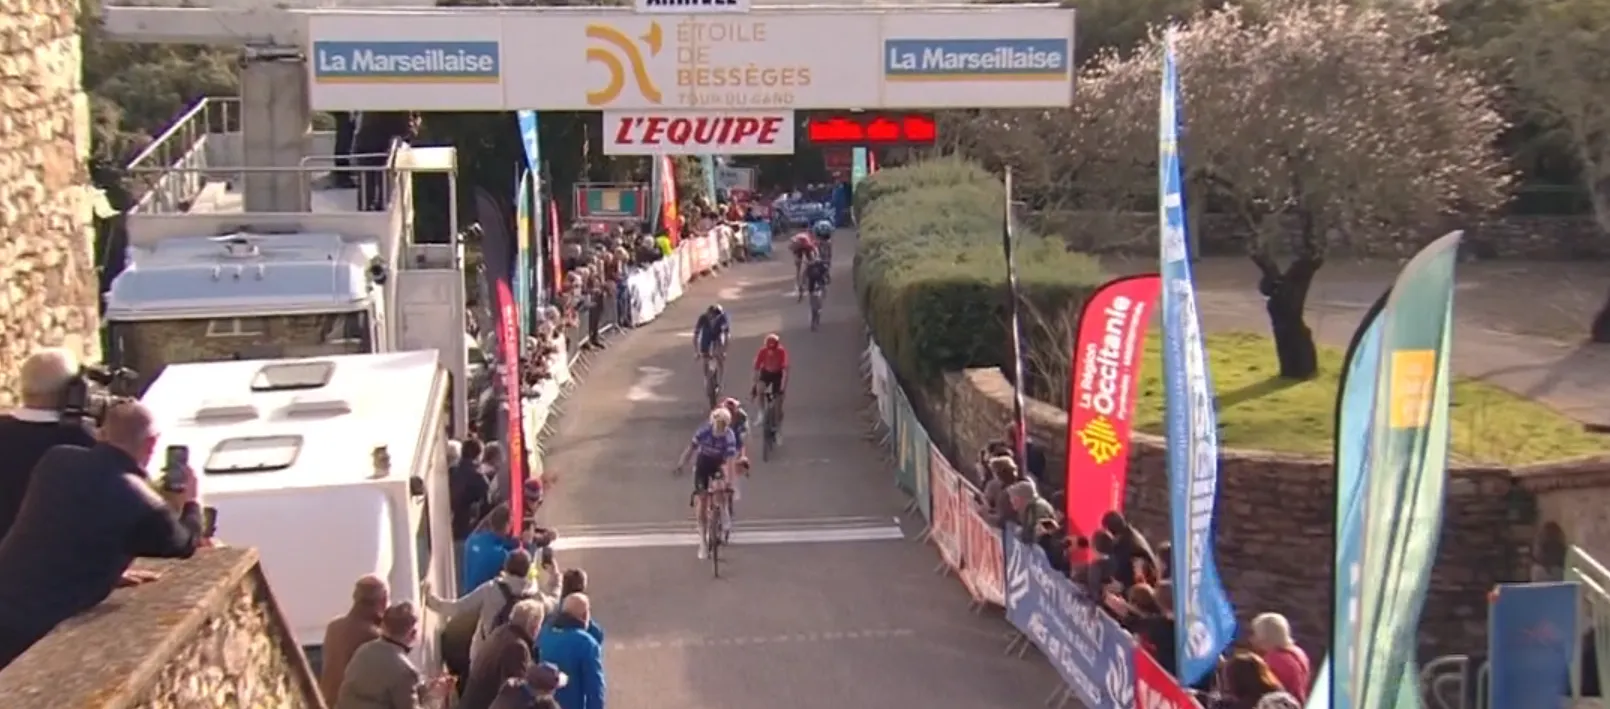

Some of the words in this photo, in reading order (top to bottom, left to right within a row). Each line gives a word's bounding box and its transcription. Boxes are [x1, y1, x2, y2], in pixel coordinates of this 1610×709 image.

[677, 20, 766, 42] ÉTOILE
[319, 50, 346, 71] La
[352, 49, 494, 72] Marseillaise
[677, 46, 710, 64] DE
[891, 48, 917, 69] La
[923, 46, 1061, 69] Marseillaise
[677, 63, 811, 86] BESSÈGES
[615, 117, 784, 145] L'EQUIPE
[1093, 297, 1131, 414] Occitanie
[1078, 394, 1091, 409] La
